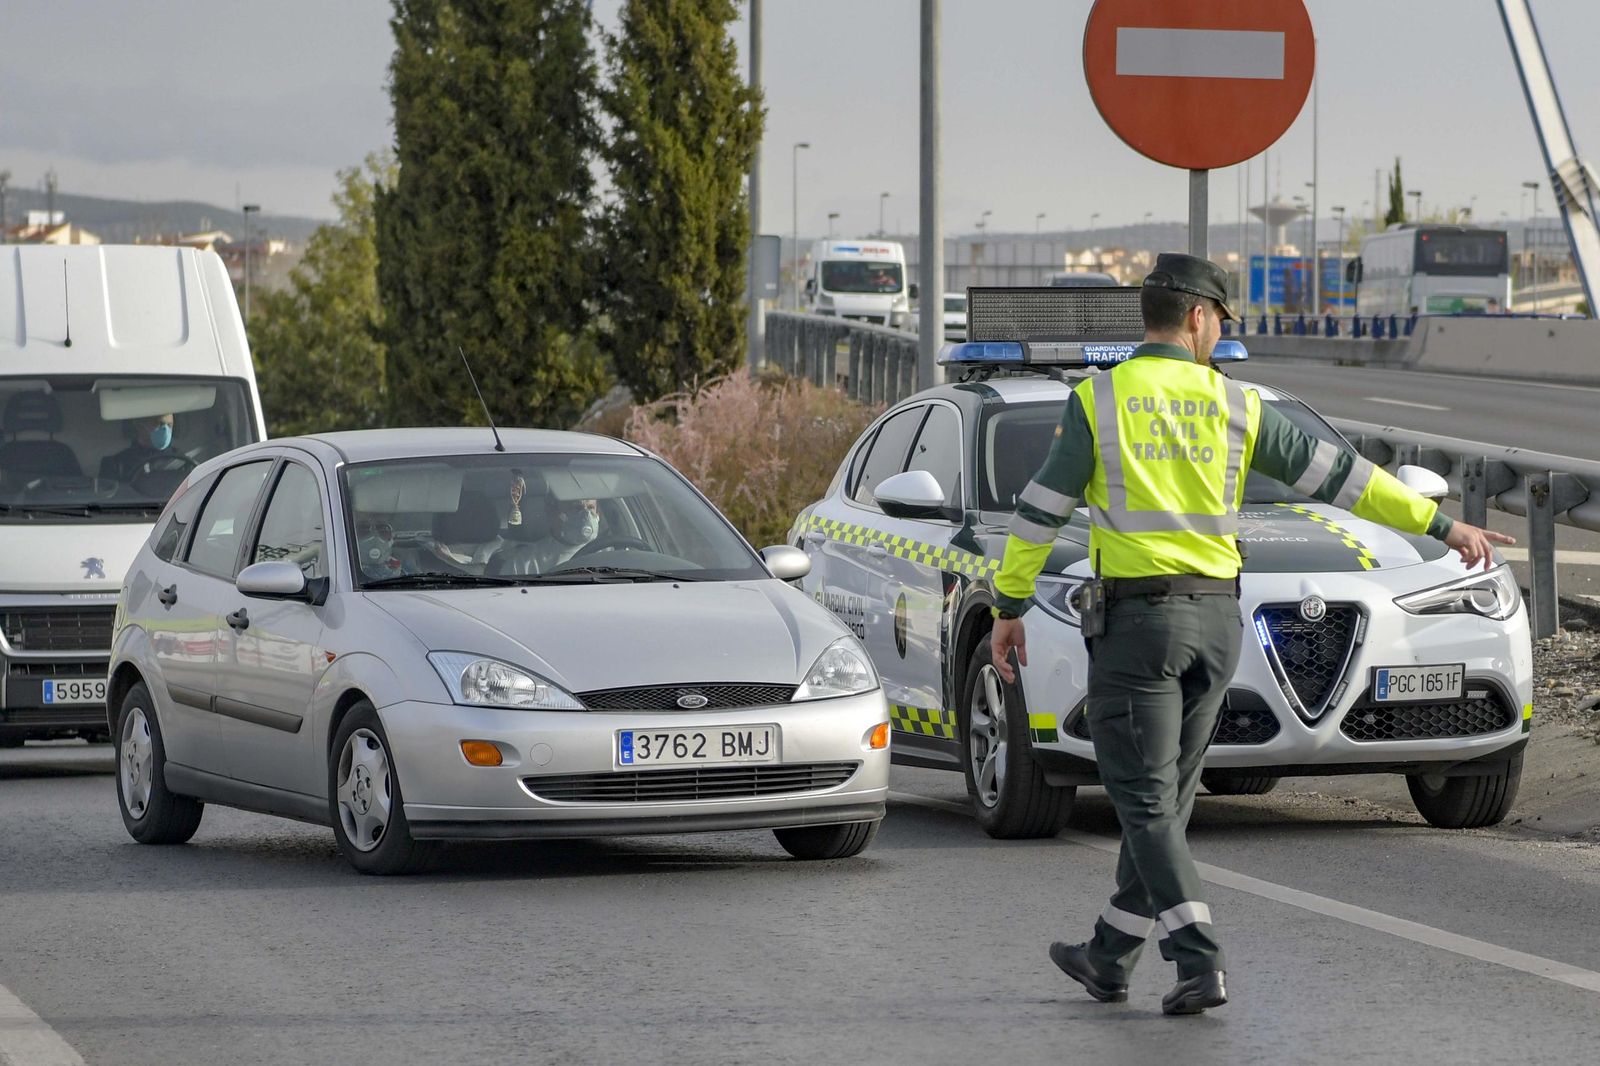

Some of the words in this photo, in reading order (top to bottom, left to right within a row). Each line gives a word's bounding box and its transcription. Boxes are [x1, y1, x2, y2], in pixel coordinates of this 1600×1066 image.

[1127, 396, 1219, 417] GUARDIA
[1150, 419, 1199, 440] CIVIL
[1133, 443, 1214, 464] TRAFICO
[57, 682, 106, 700] 5959
[1388, 674, 1416, 693] PGC
[624, 750, 630, 758] E
[637, 732, 707, 760] 3762
[721, 730, 769, 758] BMJ
